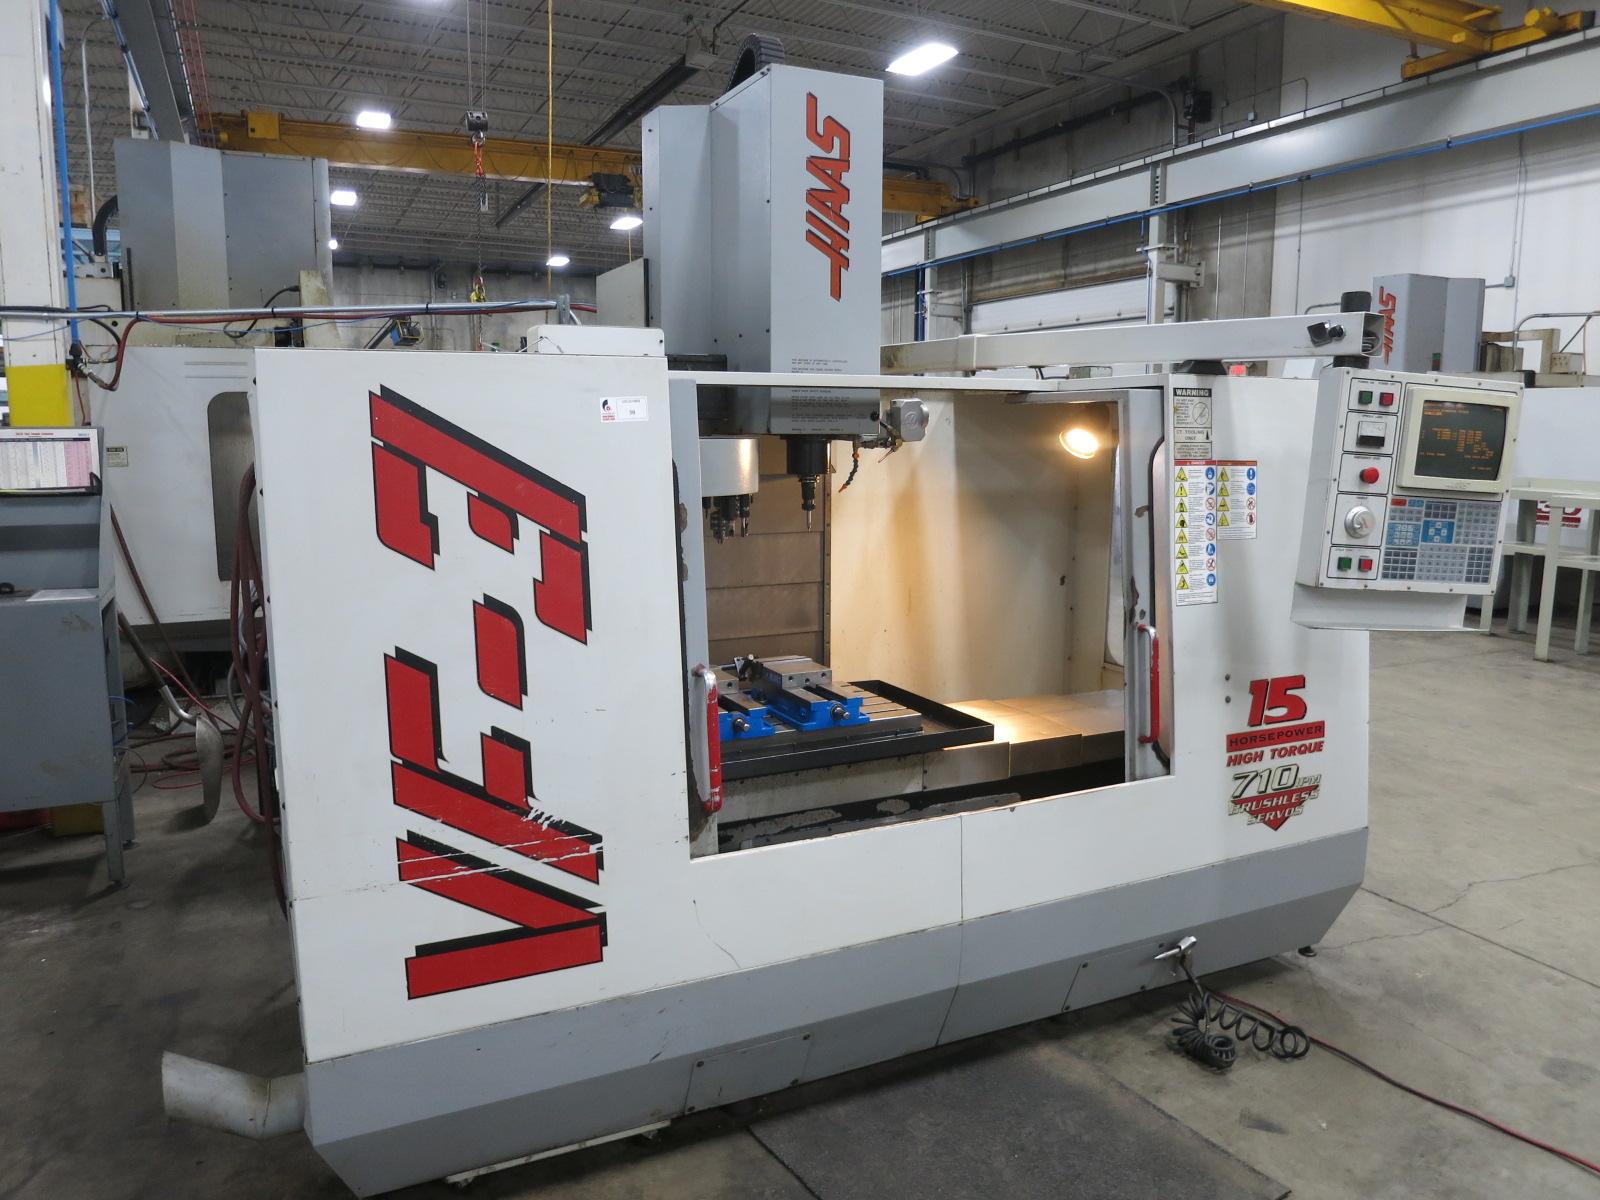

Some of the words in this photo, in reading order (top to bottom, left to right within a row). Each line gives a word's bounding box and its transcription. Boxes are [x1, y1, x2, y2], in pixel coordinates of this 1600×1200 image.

[806, 91, 850, 303] HAAS
[1175, 389, 1208, 397] WARNING
[1248, 674, 1307, 727] 15
[1229, 726, 1323, 747] HORSEPOWER
[1226, 750, 1265, 768] HIGH
[1270, 741, 1325, 760] TORQUE
[1231, 763, 1300, 799] 710
[1228, 789, 1320, 816] BRUSHLESS
[1246, 804, 1304, 826] SERVOS
